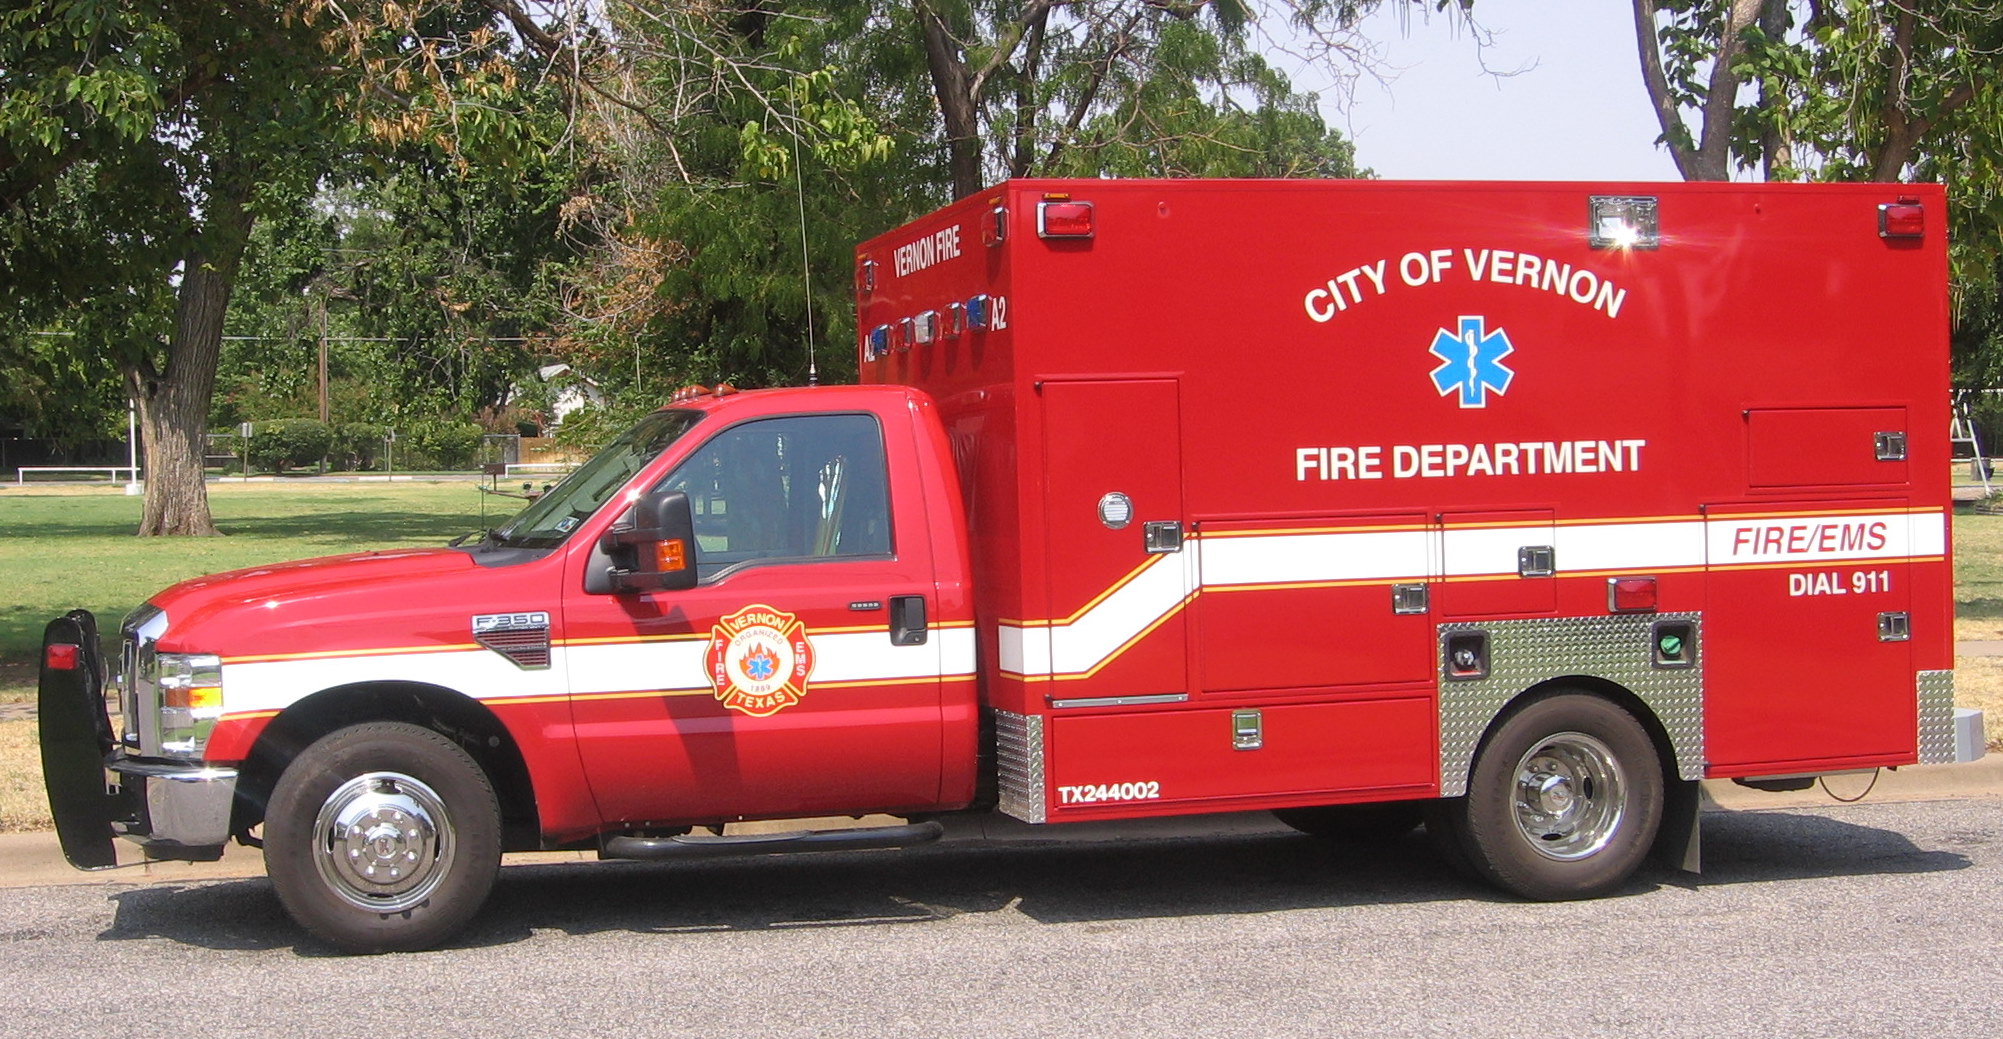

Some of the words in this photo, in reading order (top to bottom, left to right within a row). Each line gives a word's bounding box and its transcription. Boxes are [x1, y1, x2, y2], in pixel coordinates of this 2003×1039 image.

[893, 234, 935, 278] VERNON
[936, 224, 961, 263] FIRE
[1304, 259, 1387, 323] CITY
[1399, 249, 1453, 287] OF
[1463, 248, 1627, 319] VERNON
[991, 296, 1007, 331] A2
[1296, 446, 1383, 481] FIRE
[1393, 439, 1646, 479] DEPARTMENT
[1733, 521, 1887, 556] FIRE/EMS
[1789, 572, 1846, 596] DIAL
[1852, 570, 1890, 594] 911
[730, 613, 785, 630] VERNON
[734, 629, 784, 647] ORGANIZED
[715, 639, 726, 686] FIRE
[795, 642, 806, 677] EMS
[736, 691, 786, 708] TEXAS
[1057, 781, 1160, 804] TX244002
